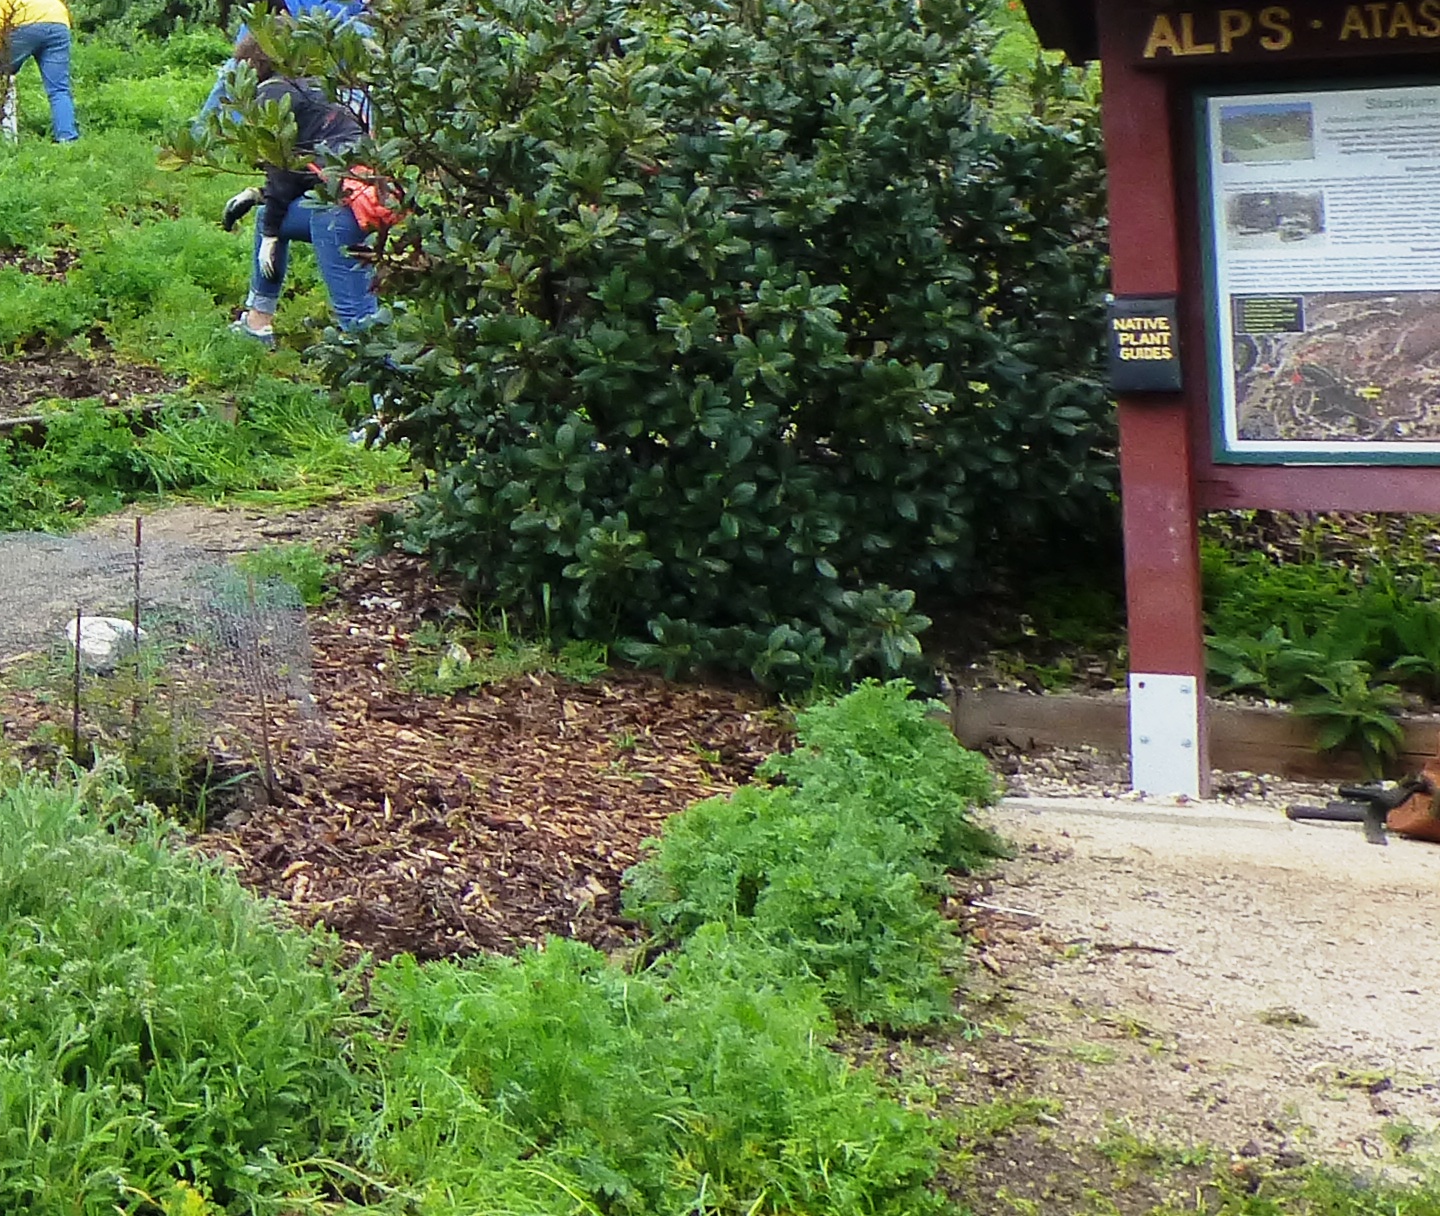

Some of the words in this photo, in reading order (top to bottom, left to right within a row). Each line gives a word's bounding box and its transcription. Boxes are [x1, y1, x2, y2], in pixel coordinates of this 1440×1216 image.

[1143, 6, 1294, 58] ALPS
[1112, 316, 1170, 330] NATIVE
[1119, 332, 1172, 346] PLANT
[1120, 347, 1173, 360] GUIDES
